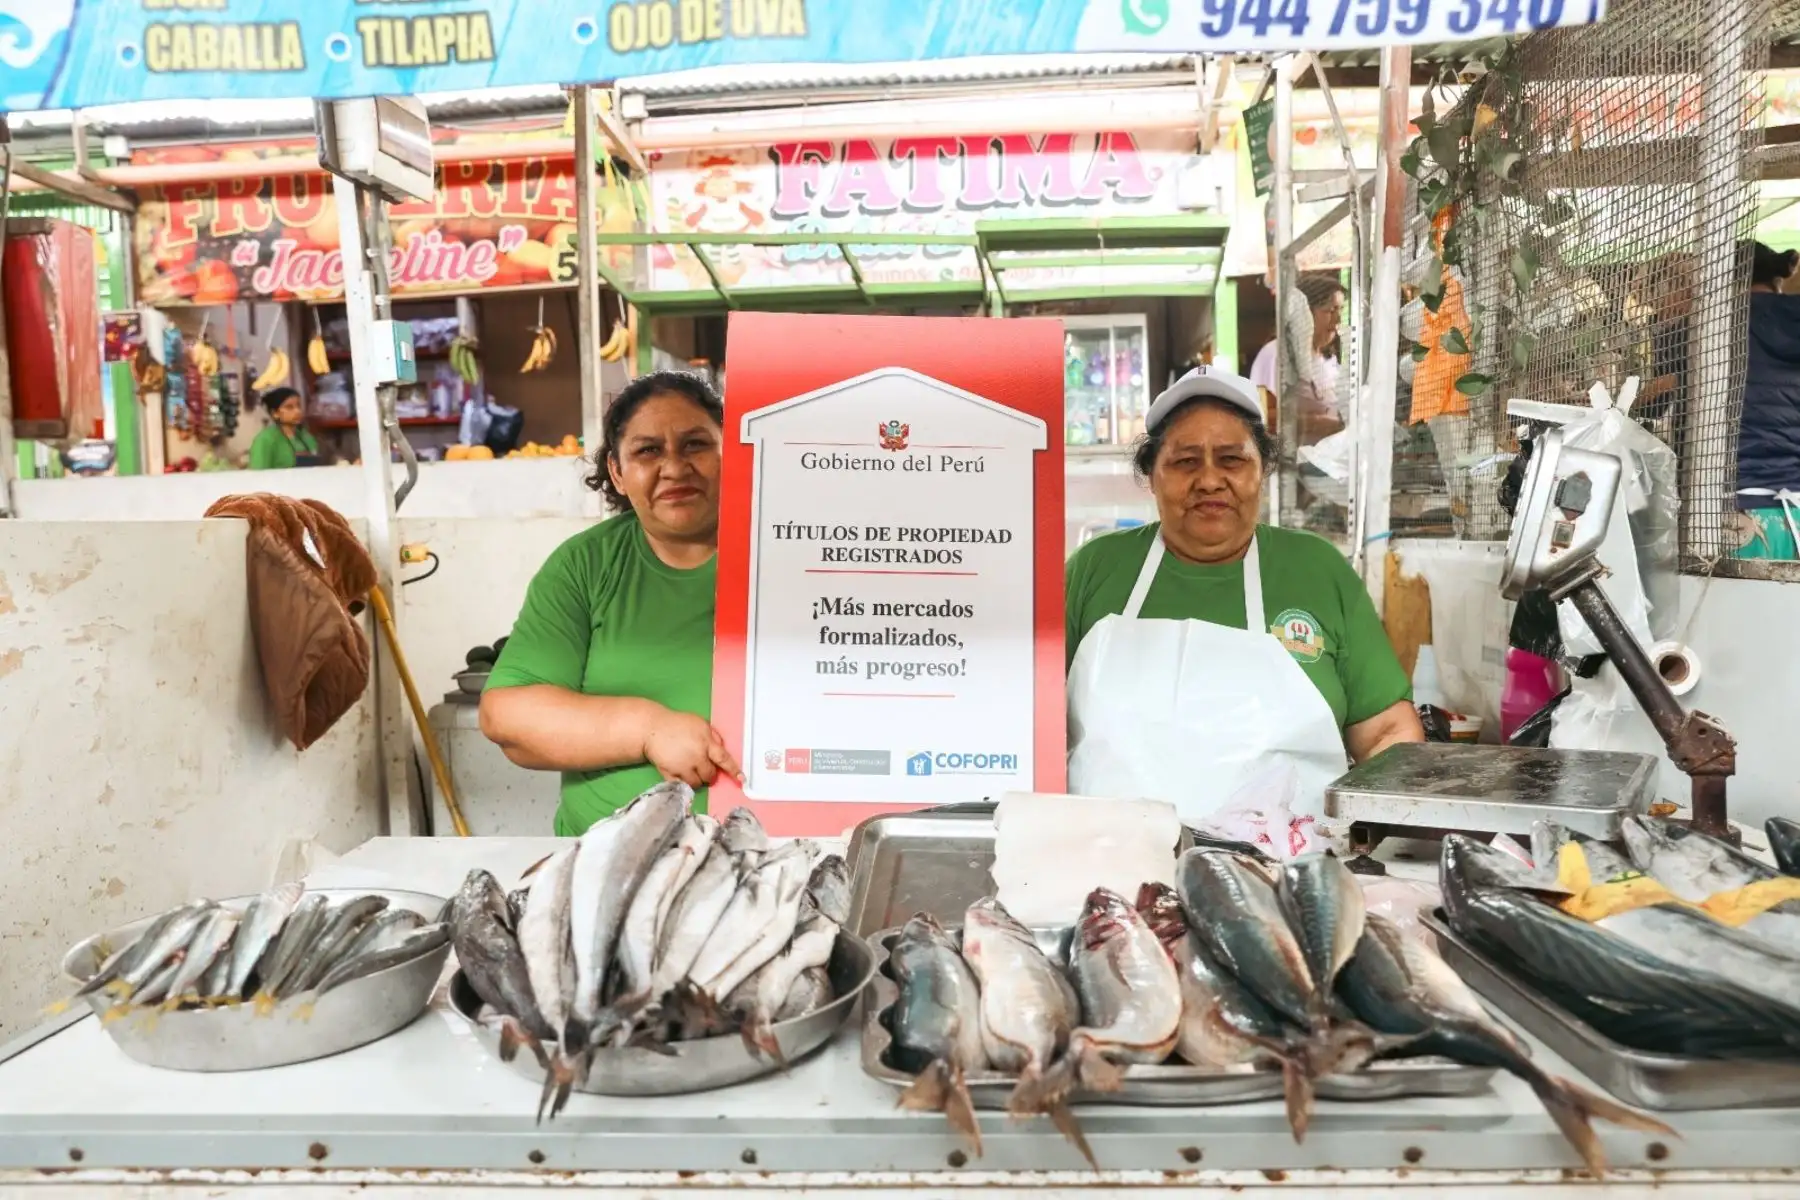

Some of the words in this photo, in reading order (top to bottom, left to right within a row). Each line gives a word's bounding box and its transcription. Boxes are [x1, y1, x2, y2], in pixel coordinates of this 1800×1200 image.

[608, 2, 674, 54] OJO
[677, 0, 722, 45] DE
[729, 0, 810, 39] UVA
[1200, 0, 1309, 37] 944
[144, 22, 306, 73] CABALLA
[356, 11, 496, 68] TILAPIA
[768, 131, 1157, 220] FATIMA
[160, 157, 598, 248] FRURIA
[801, 452, 895, 471] Gobierno
[902, 454, 931, 472] del
[940, 455, 985, 473] Perú
[772, 520, 858, 541] TÍTULOS
[865, 527, 891, 542] DE
[897, 527, 1012, 544] PROPIEDAD
[821, 548, 963, 564] REGISTRADOS
[812, 597, 865, 619] ¡Más
[872, 599, 974, 618] mercados
[819, 626, 964, 650] formalizados,
[815, 656, 858, 675] más
[866, 659, 967, 681] progreso!
[935, 752, 1018, 769] COFOPRI
